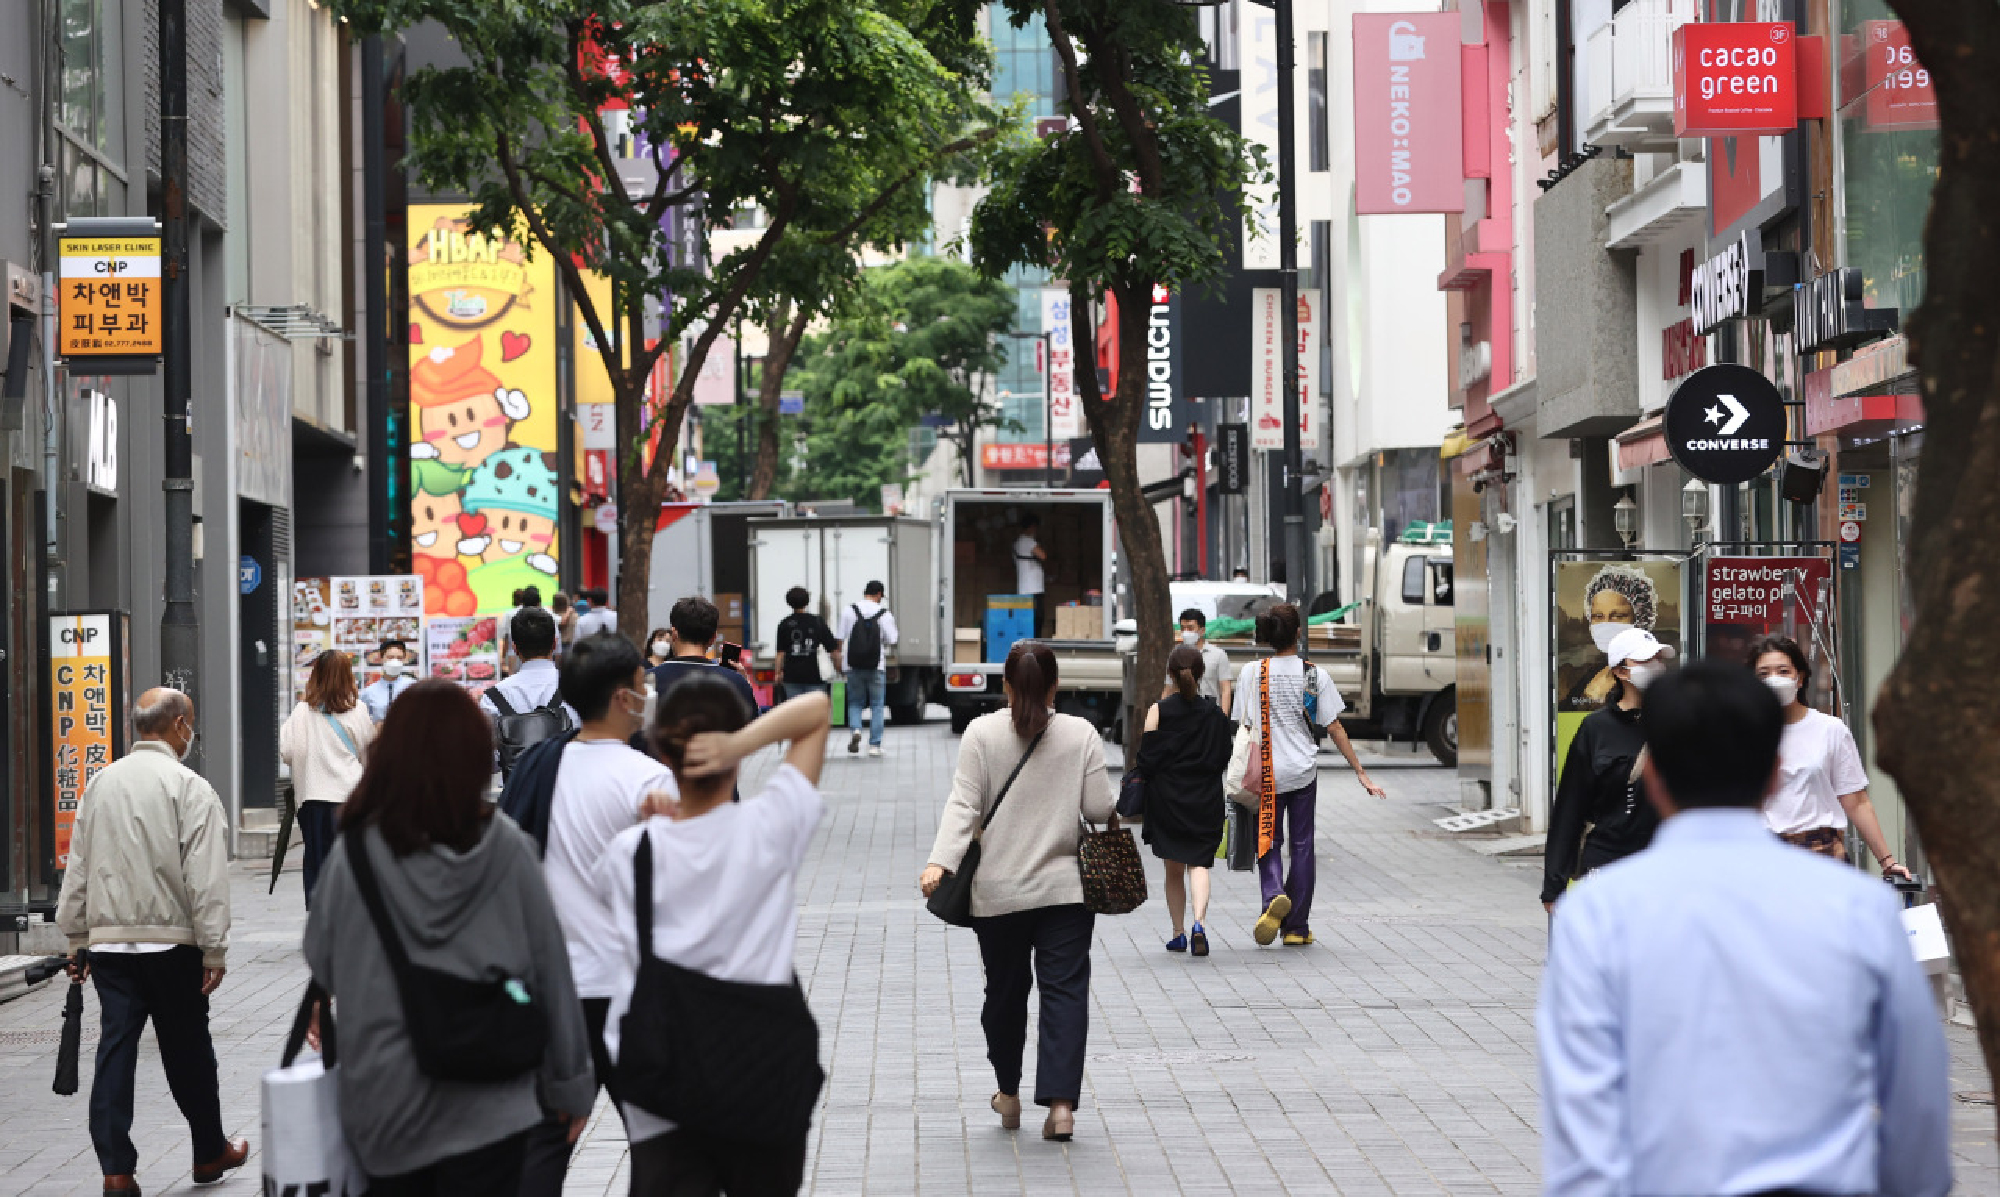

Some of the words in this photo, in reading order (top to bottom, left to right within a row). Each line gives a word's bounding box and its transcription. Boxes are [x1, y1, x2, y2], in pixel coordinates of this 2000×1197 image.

[1701, 47, 1777, 67] cacao
[1701, 75, 1778, 100] green
[1390, 66, 1411, 205] NEKO:MAO
[66, 244, 88, 252] SKIN
[91, 244, 121, 252] LASER
[124, 244, 154, 252] CLINIC
[94, 261, 128, 273] CNP
[73, 283, 150, 309] 차앤박
[73, 313, 149, 337] 피부과
[1687, 438, 1770, 450] CONVERSE
[1712, 584, 1766, 603] gelato
[61, 627, 99, 644] CNP
[57, 665, 75, 738] CNP
[83, 663, 107, 738] 차앤박
